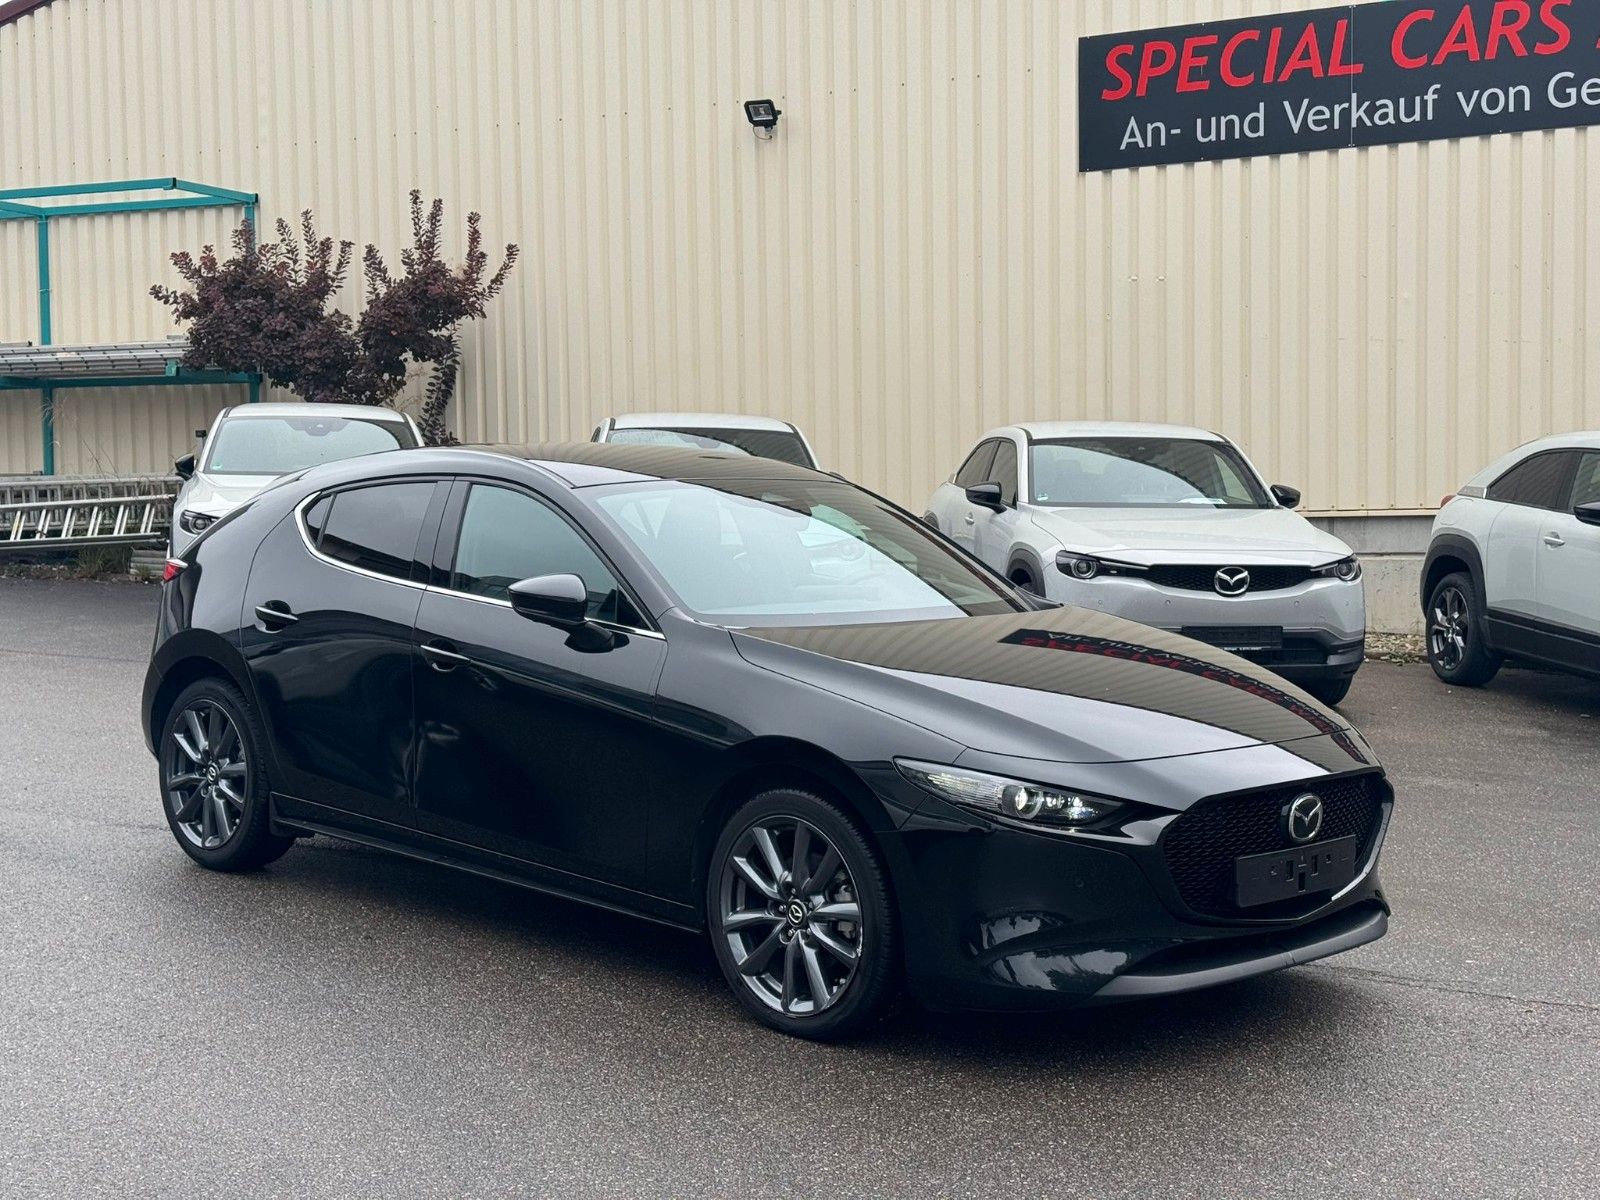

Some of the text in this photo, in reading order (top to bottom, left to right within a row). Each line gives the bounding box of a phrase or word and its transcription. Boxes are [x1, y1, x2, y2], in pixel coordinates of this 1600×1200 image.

[1101, 0, 1573, 101] SPECIAL CARS
[1119, 71, 1600, 150] An- und Verkauf von Ge
